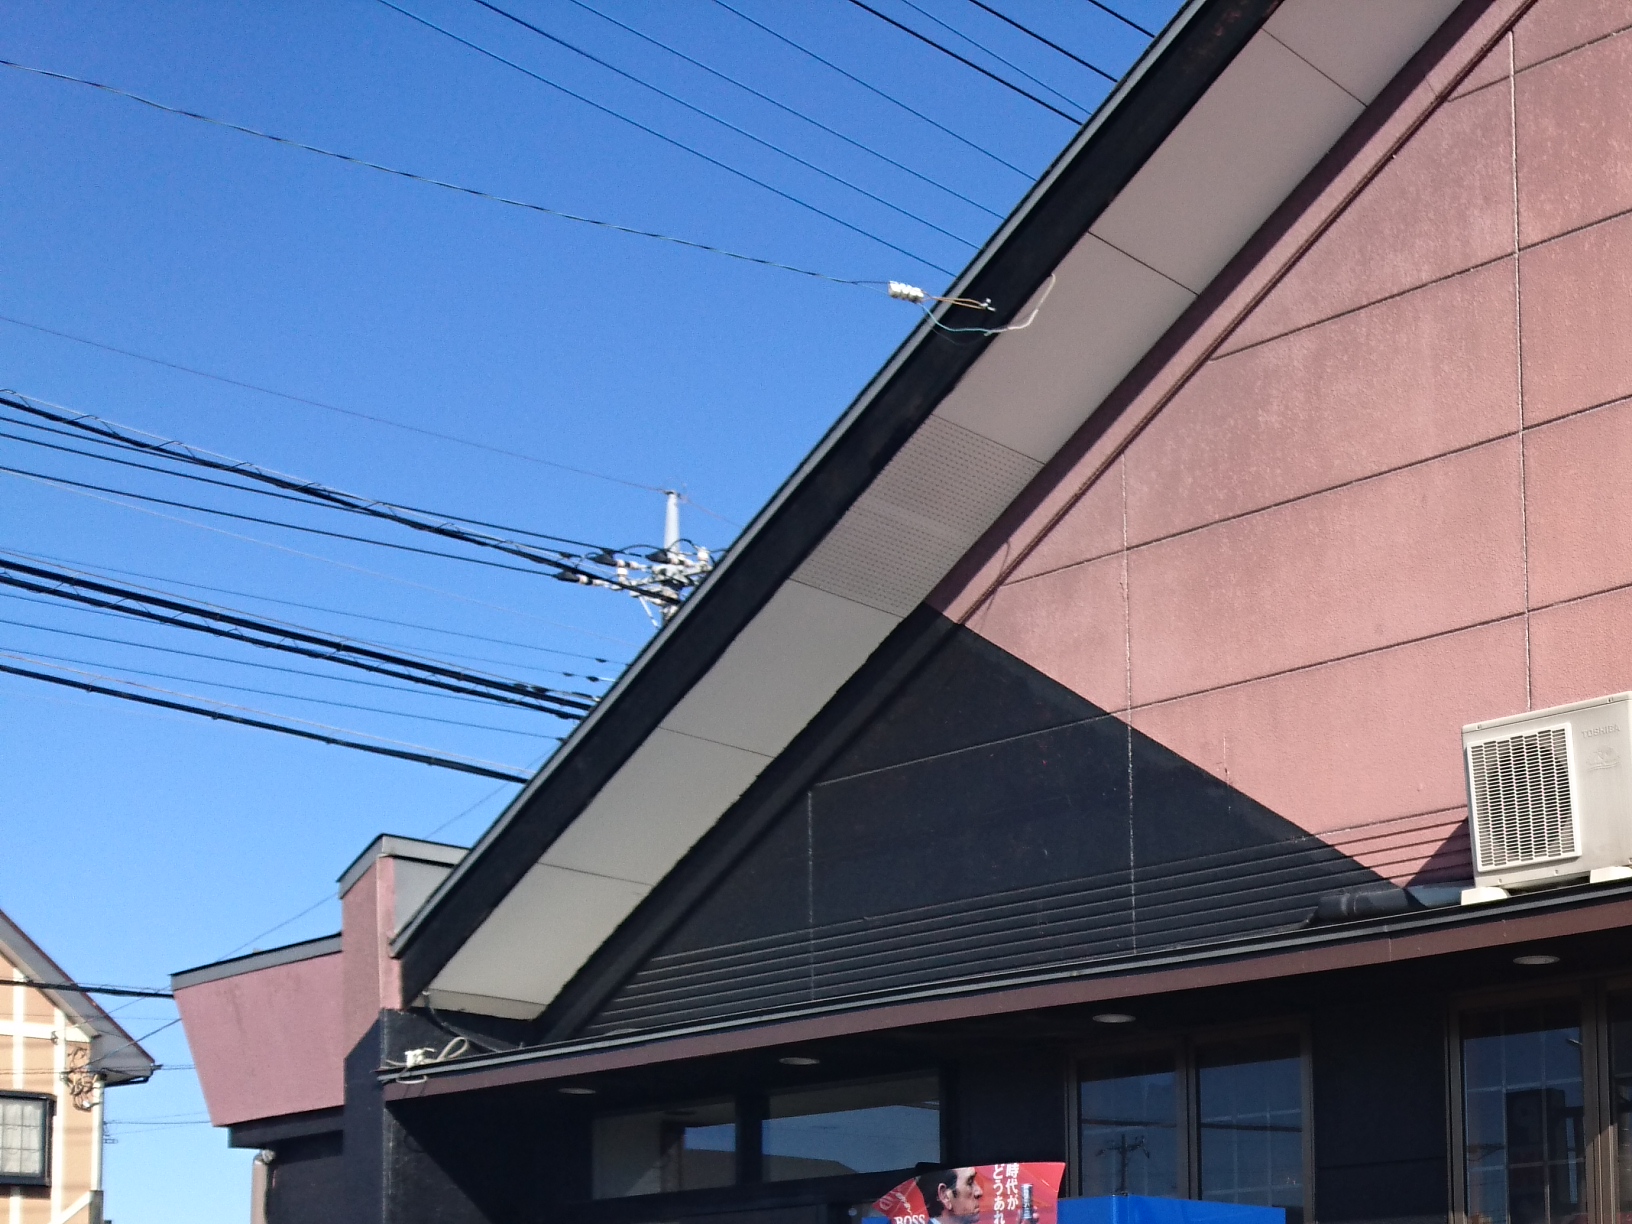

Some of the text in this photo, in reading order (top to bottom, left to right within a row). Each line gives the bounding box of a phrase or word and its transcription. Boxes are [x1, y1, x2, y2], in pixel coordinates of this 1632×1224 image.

[1581, 724, 1621, 739] TOSHIBA
[1005, 1163, 1020, 1211] 時代が
